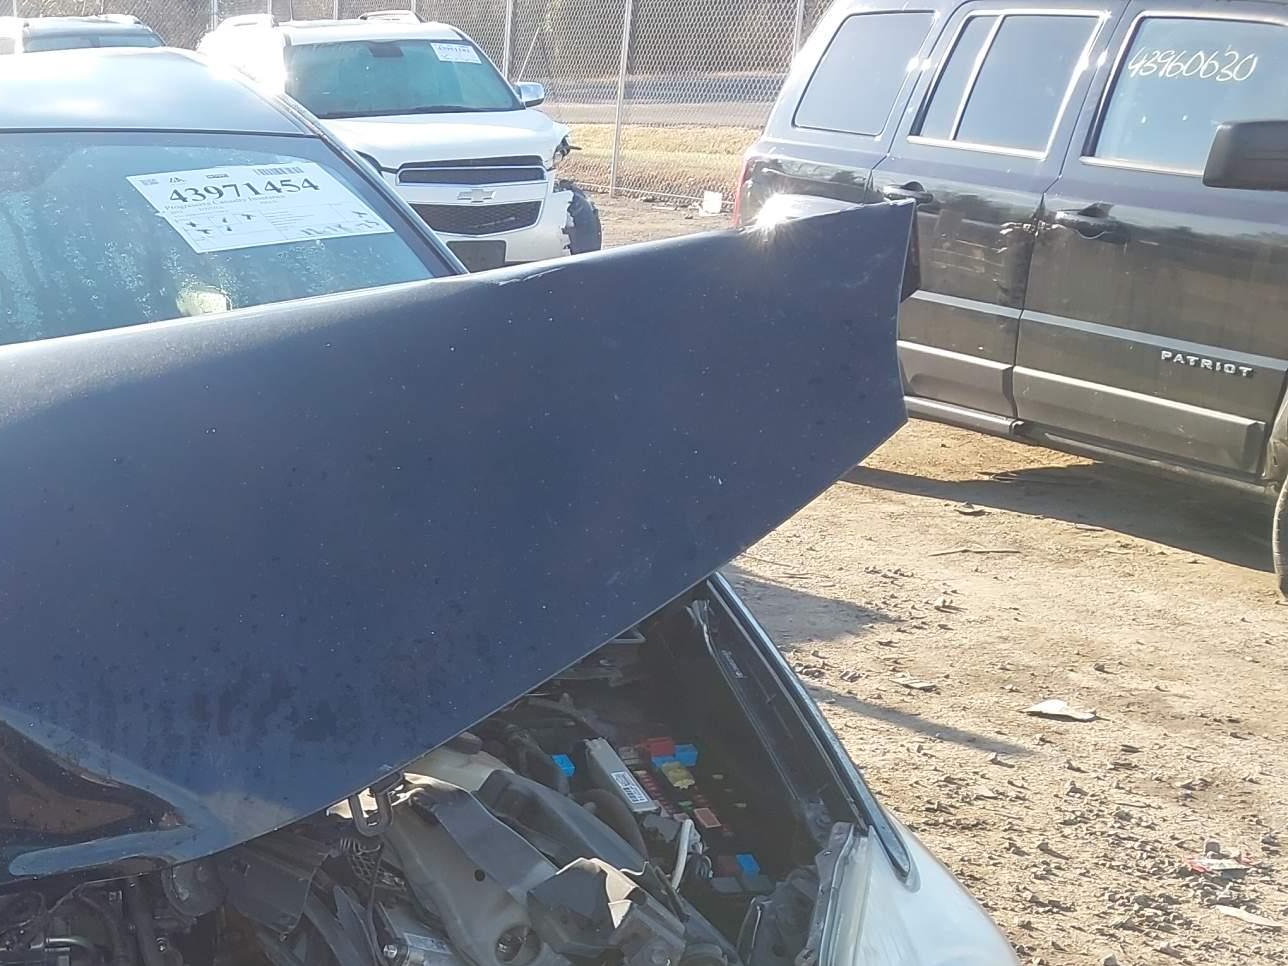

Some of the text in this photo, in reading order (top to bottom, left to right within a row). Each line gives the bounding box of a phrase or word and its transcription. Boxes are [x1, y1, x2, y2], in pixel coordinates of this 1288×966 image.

[1128, 45, 1258, 82] 43960630
[169, 177, 320, 203] 43971454
[1161, 350, 1253, 377] PATRIOT
